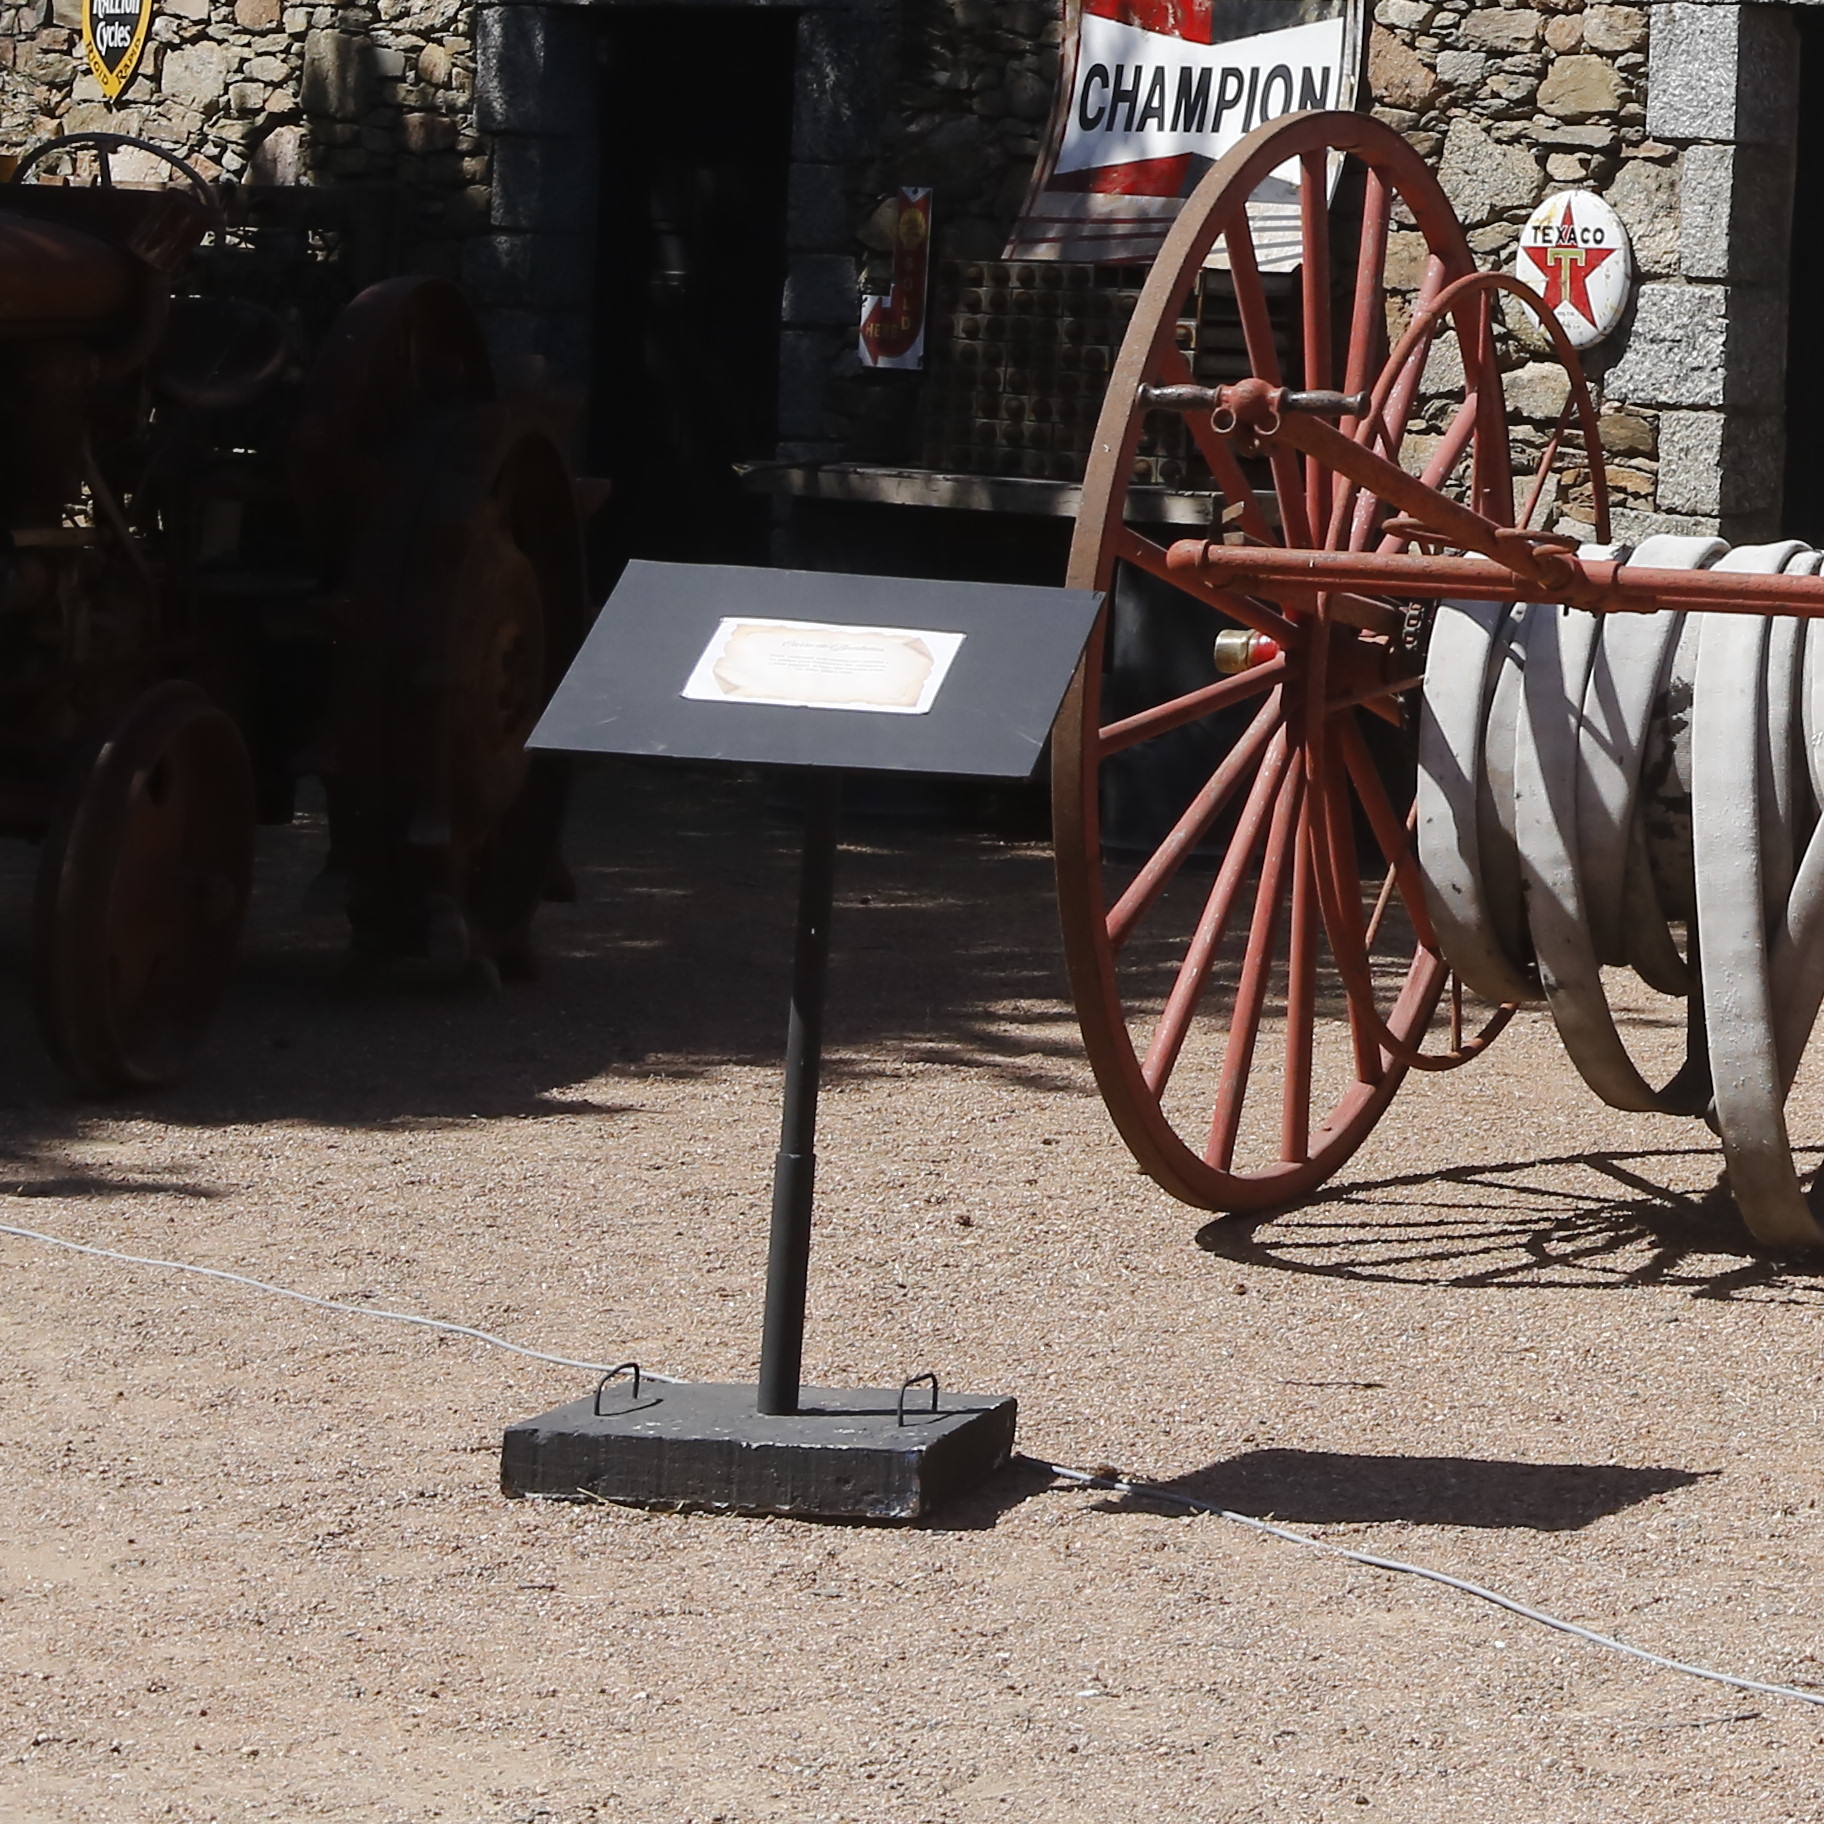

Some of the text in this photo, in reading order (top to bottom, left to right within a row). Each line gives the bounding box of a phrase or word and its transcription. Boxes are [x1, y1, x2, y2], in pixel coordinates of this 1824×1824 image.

[86, 38, 141, 86] RIGID RAPID
[96, 21, 131, 56] Cycles
[1078, 62, 1332, 133] CHAMPION
[1531, 225, 1605, 245] TEXACO
[901, 256, 914, 330] SOLD
[1547, 247, 1586, 302] T
[866, 323, 898, 338] HERE
